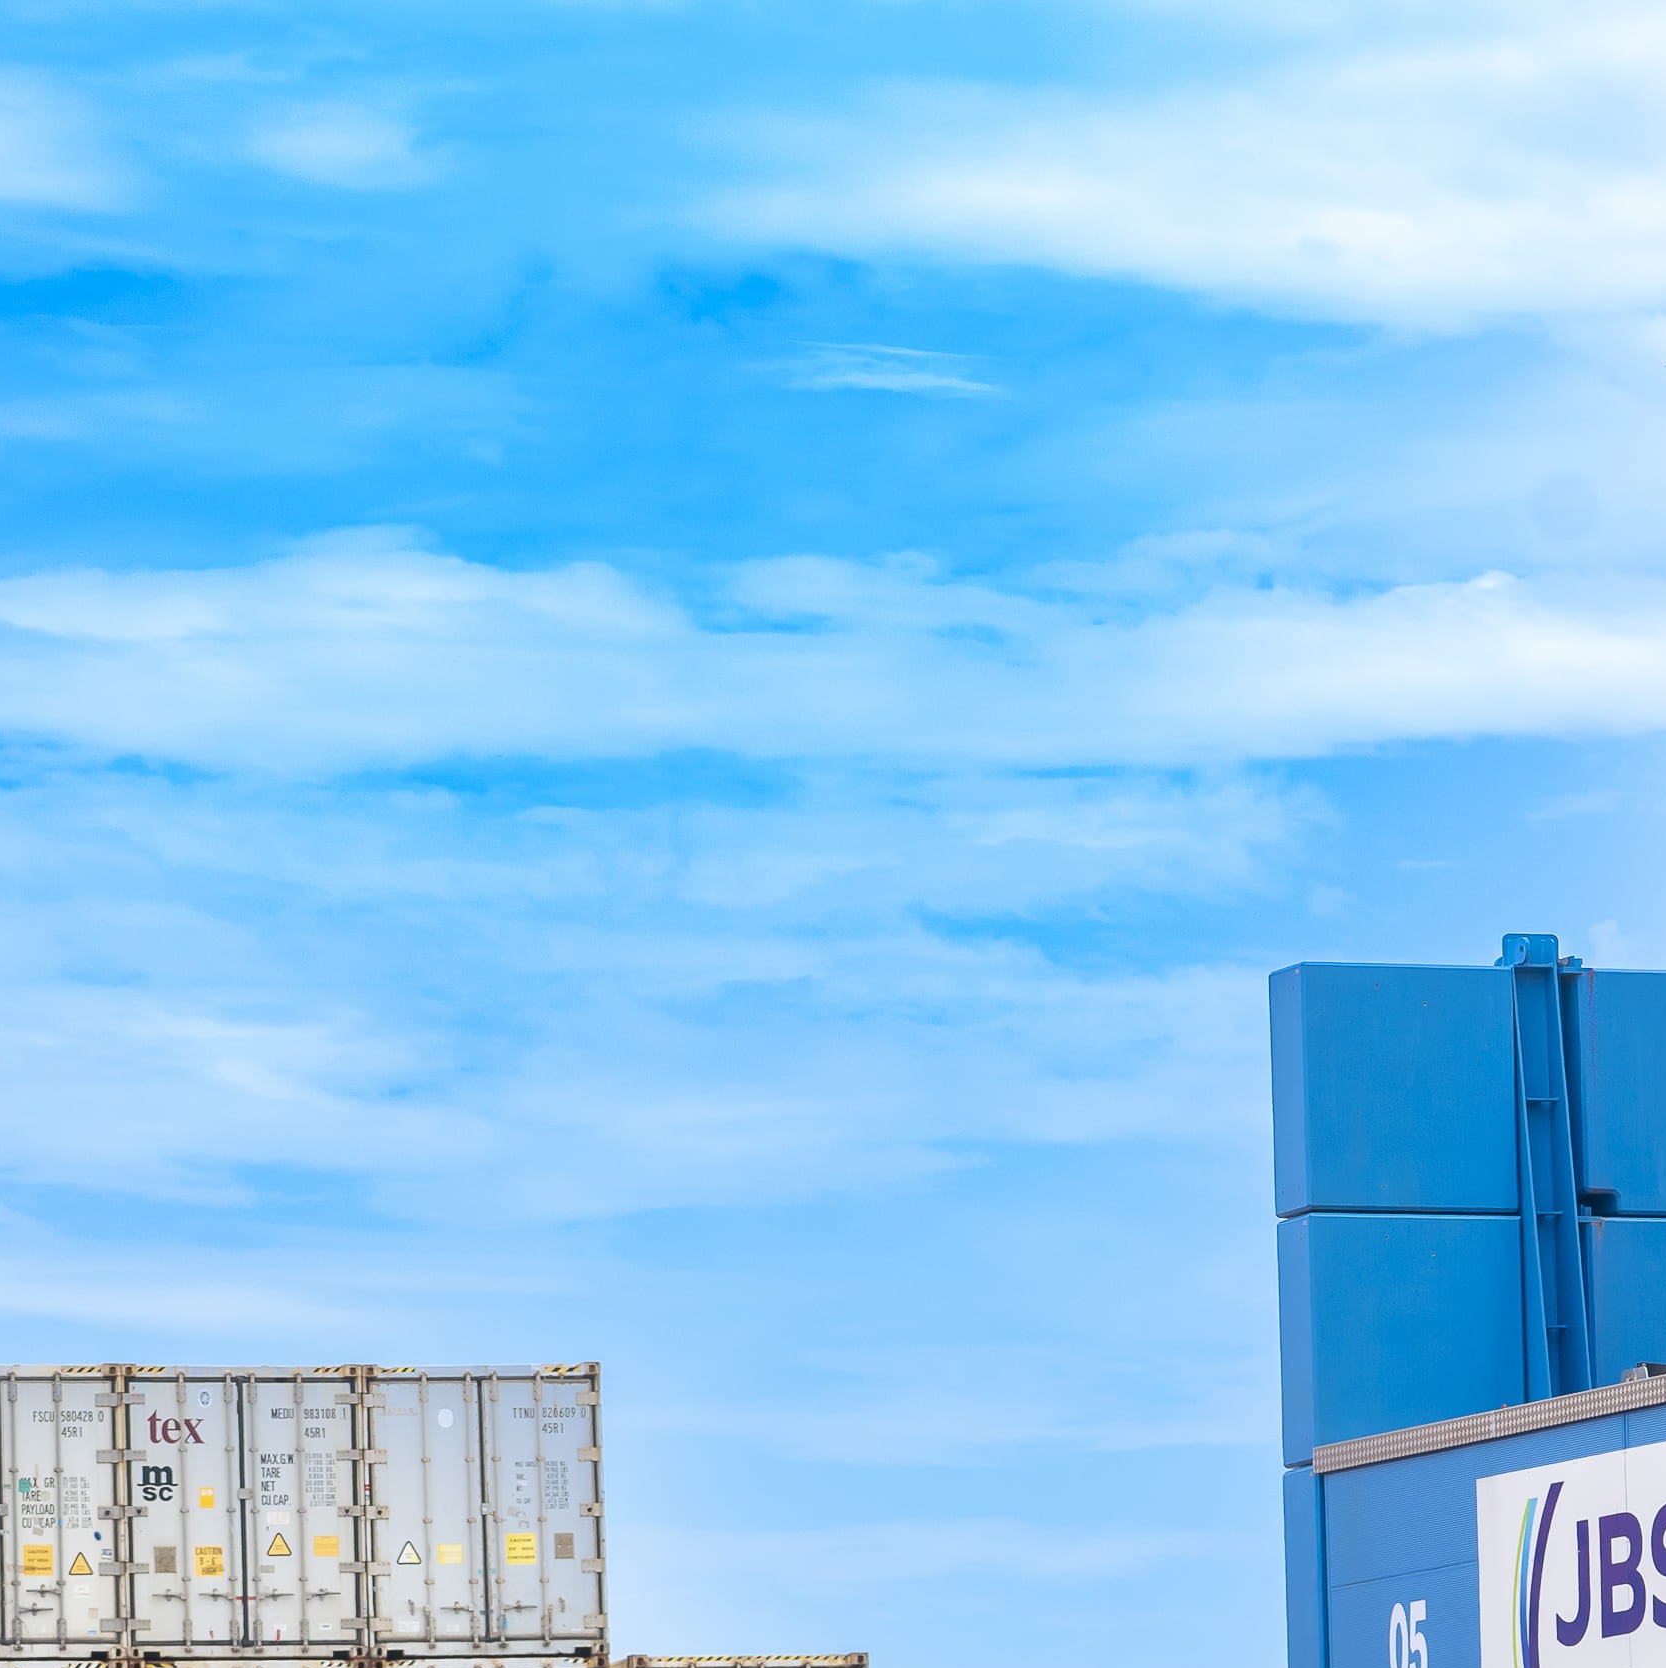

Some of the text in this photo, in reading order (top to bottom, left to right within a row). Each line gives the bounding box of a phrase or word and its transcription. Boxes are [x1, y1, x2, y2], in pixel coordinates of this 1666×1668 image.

[32, 1410, 94, 1423] FSCU 580428
[270, 1408, 337, 1420] MEDU 983108
[541, 1407, 576, 1419] 826609
[61, 1426, 83, 1439] 45R1
[147, 1411, 205, 1444] tex
[304, 1427, 326, 1439] 45R1
[260, 1466, 281, 1478] TARE
[261, 1480, 275, 1492] NET
